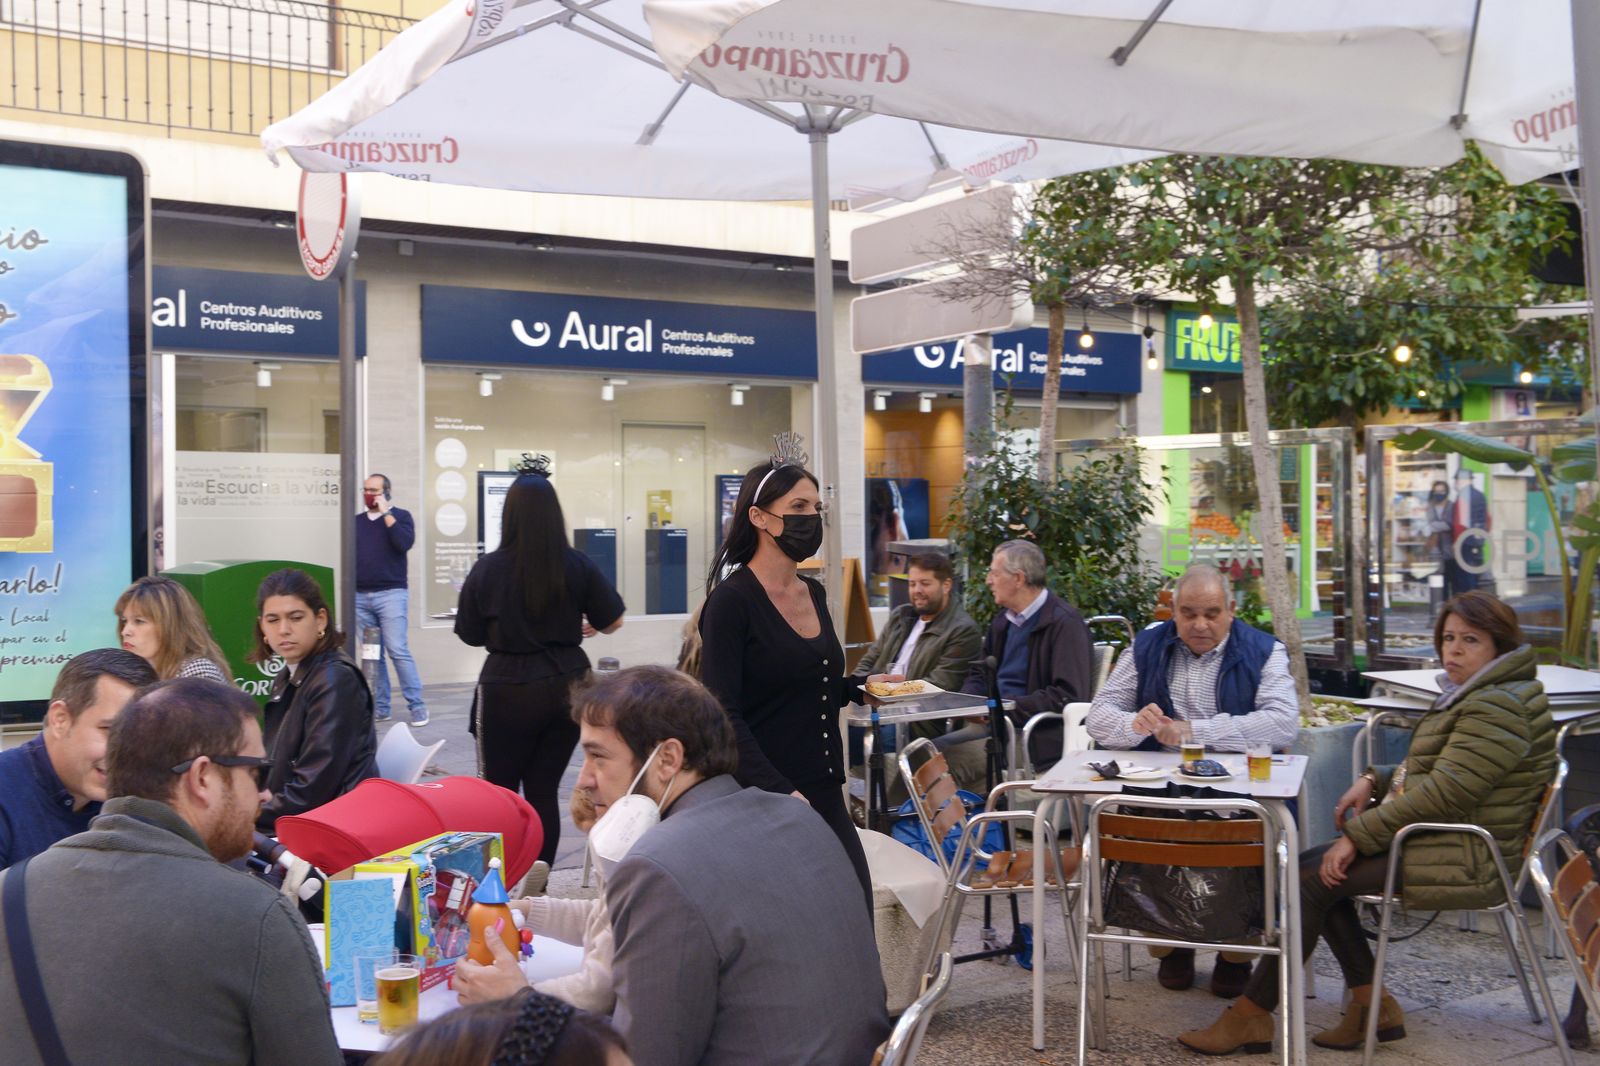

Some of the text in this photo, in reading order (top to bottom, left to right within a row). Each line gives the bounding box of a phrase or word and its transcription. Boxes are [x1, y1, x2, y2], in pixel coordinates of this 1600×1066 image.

[200, 301, 323, 320] Centros Auditivos
[200, 317, 295, 334] Profesionales
[558, 311, 652, 353] Aural
[661, 329, 756, 345] Centros Auditivos
[661, 343, 734, 357] Profesionales
[1064, 353, 1103, 366] Auditivos
[206, 479, 339, 495] Escucha la vida
[191, 495, 217, 506] vida
[11, 607, 49, 626] Local
[32, 635, 49, 643] en
[56, 629, 67, 643] el
